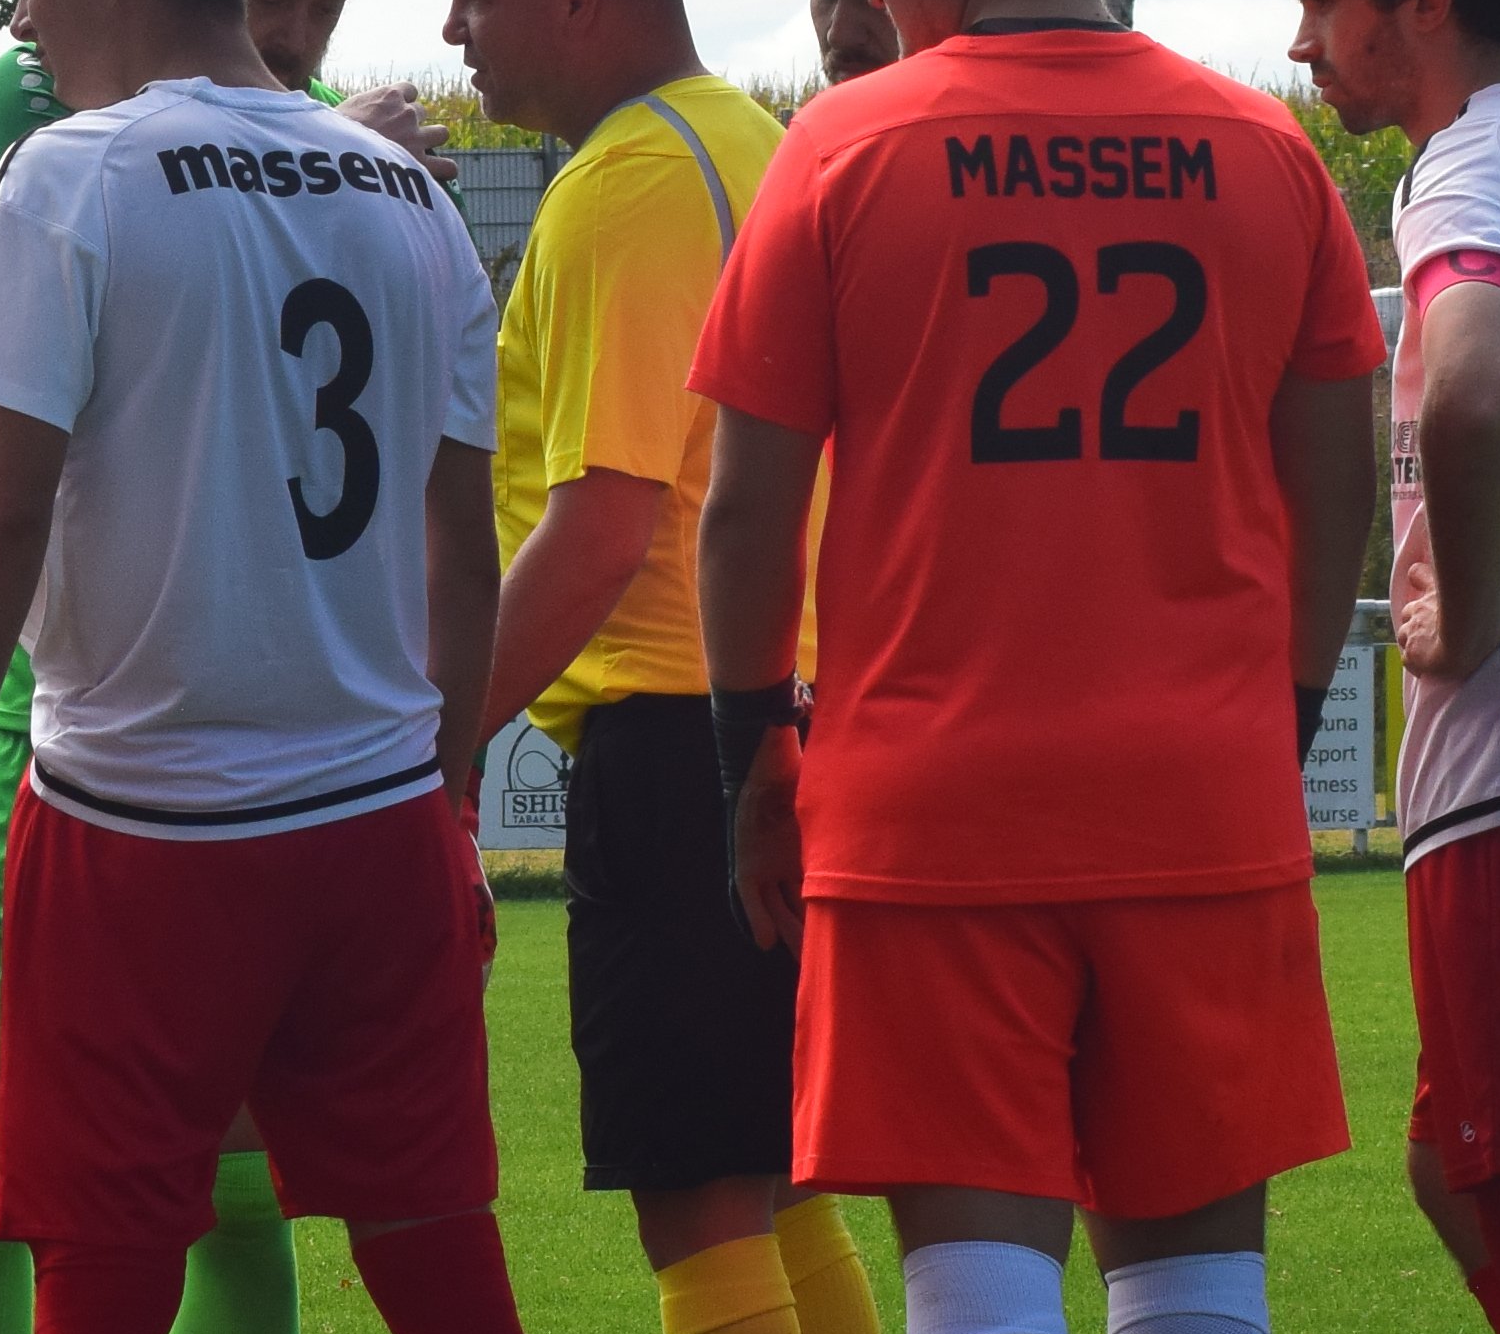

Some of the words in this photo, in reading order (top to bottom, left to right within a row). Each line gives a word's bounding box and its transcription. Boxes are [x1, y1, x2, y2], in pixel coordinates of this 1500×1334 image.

[156, 143, 435, 211] massem
[945, 134, 1218, 201] MASSEM
[967, 240, 1208, 464] 22
[280, 277, 380, 560] 3
[1306, 747, 1358, 766] sport
[1321, 718, 1358, 731] una
